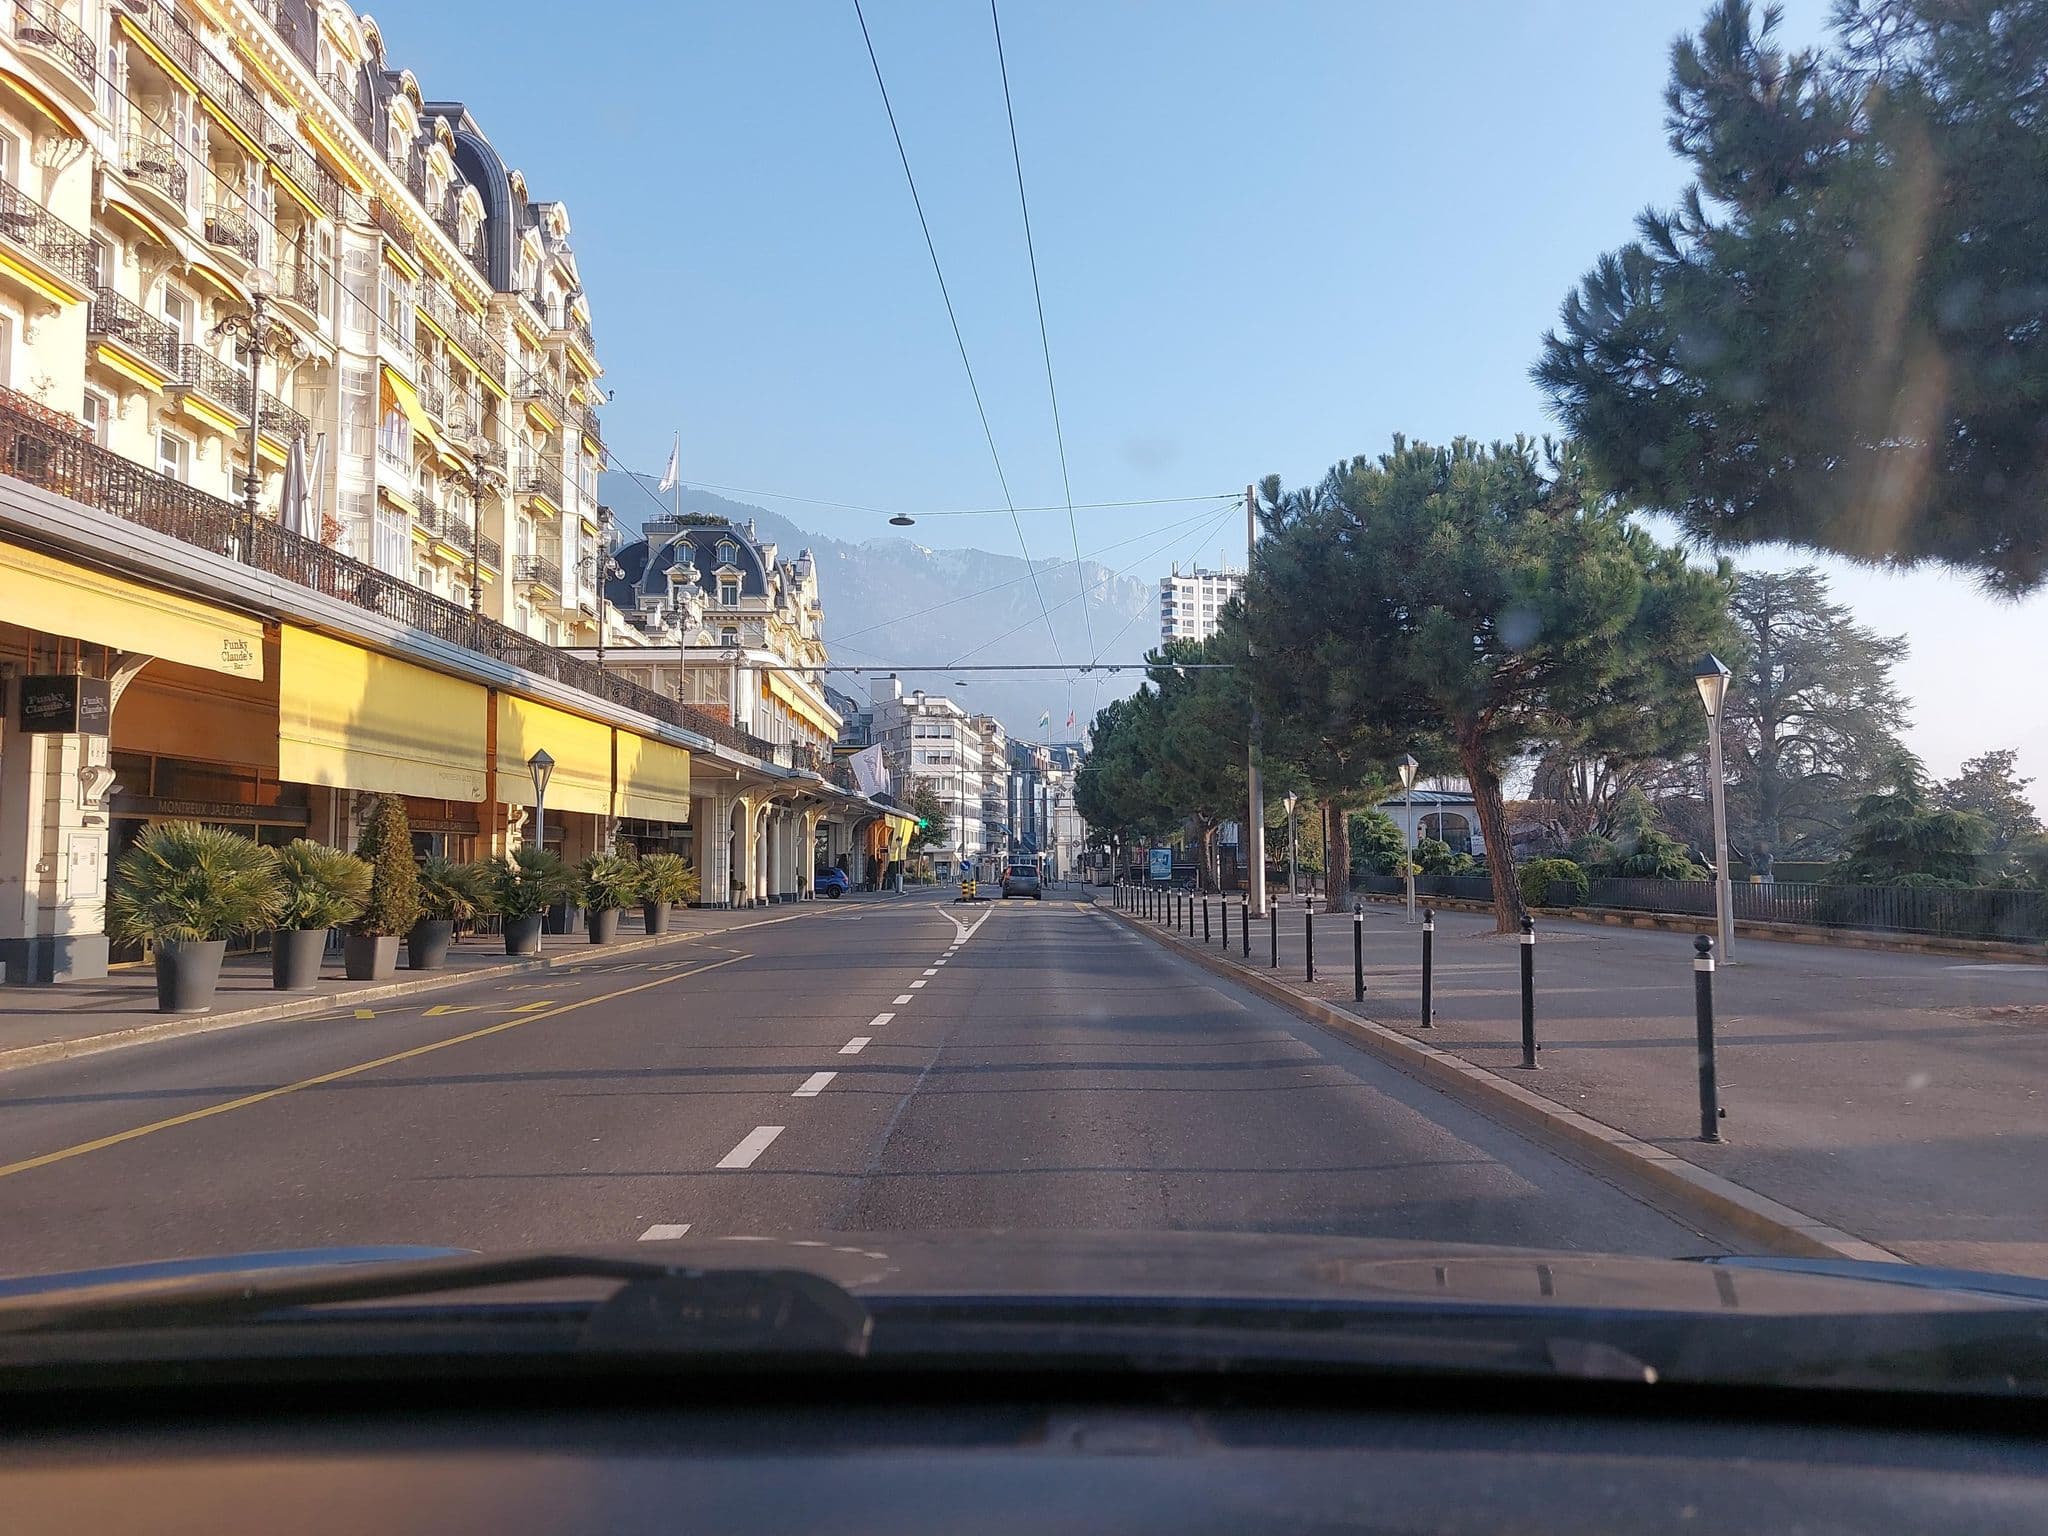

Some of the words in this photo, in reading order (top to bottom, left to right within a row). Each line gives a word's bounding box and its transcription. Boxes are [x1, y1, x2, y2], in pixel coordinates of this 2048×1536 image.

[223, 639, 248, 651] Funky
[221, 651, 253, 661] Claude's
[27, 692, 65, 704] Funky
[25, 700, 72, 714] Claude's
[159, 800, 207, 815] MONTREUX
[210, 804, 230, 816] JAZZ
